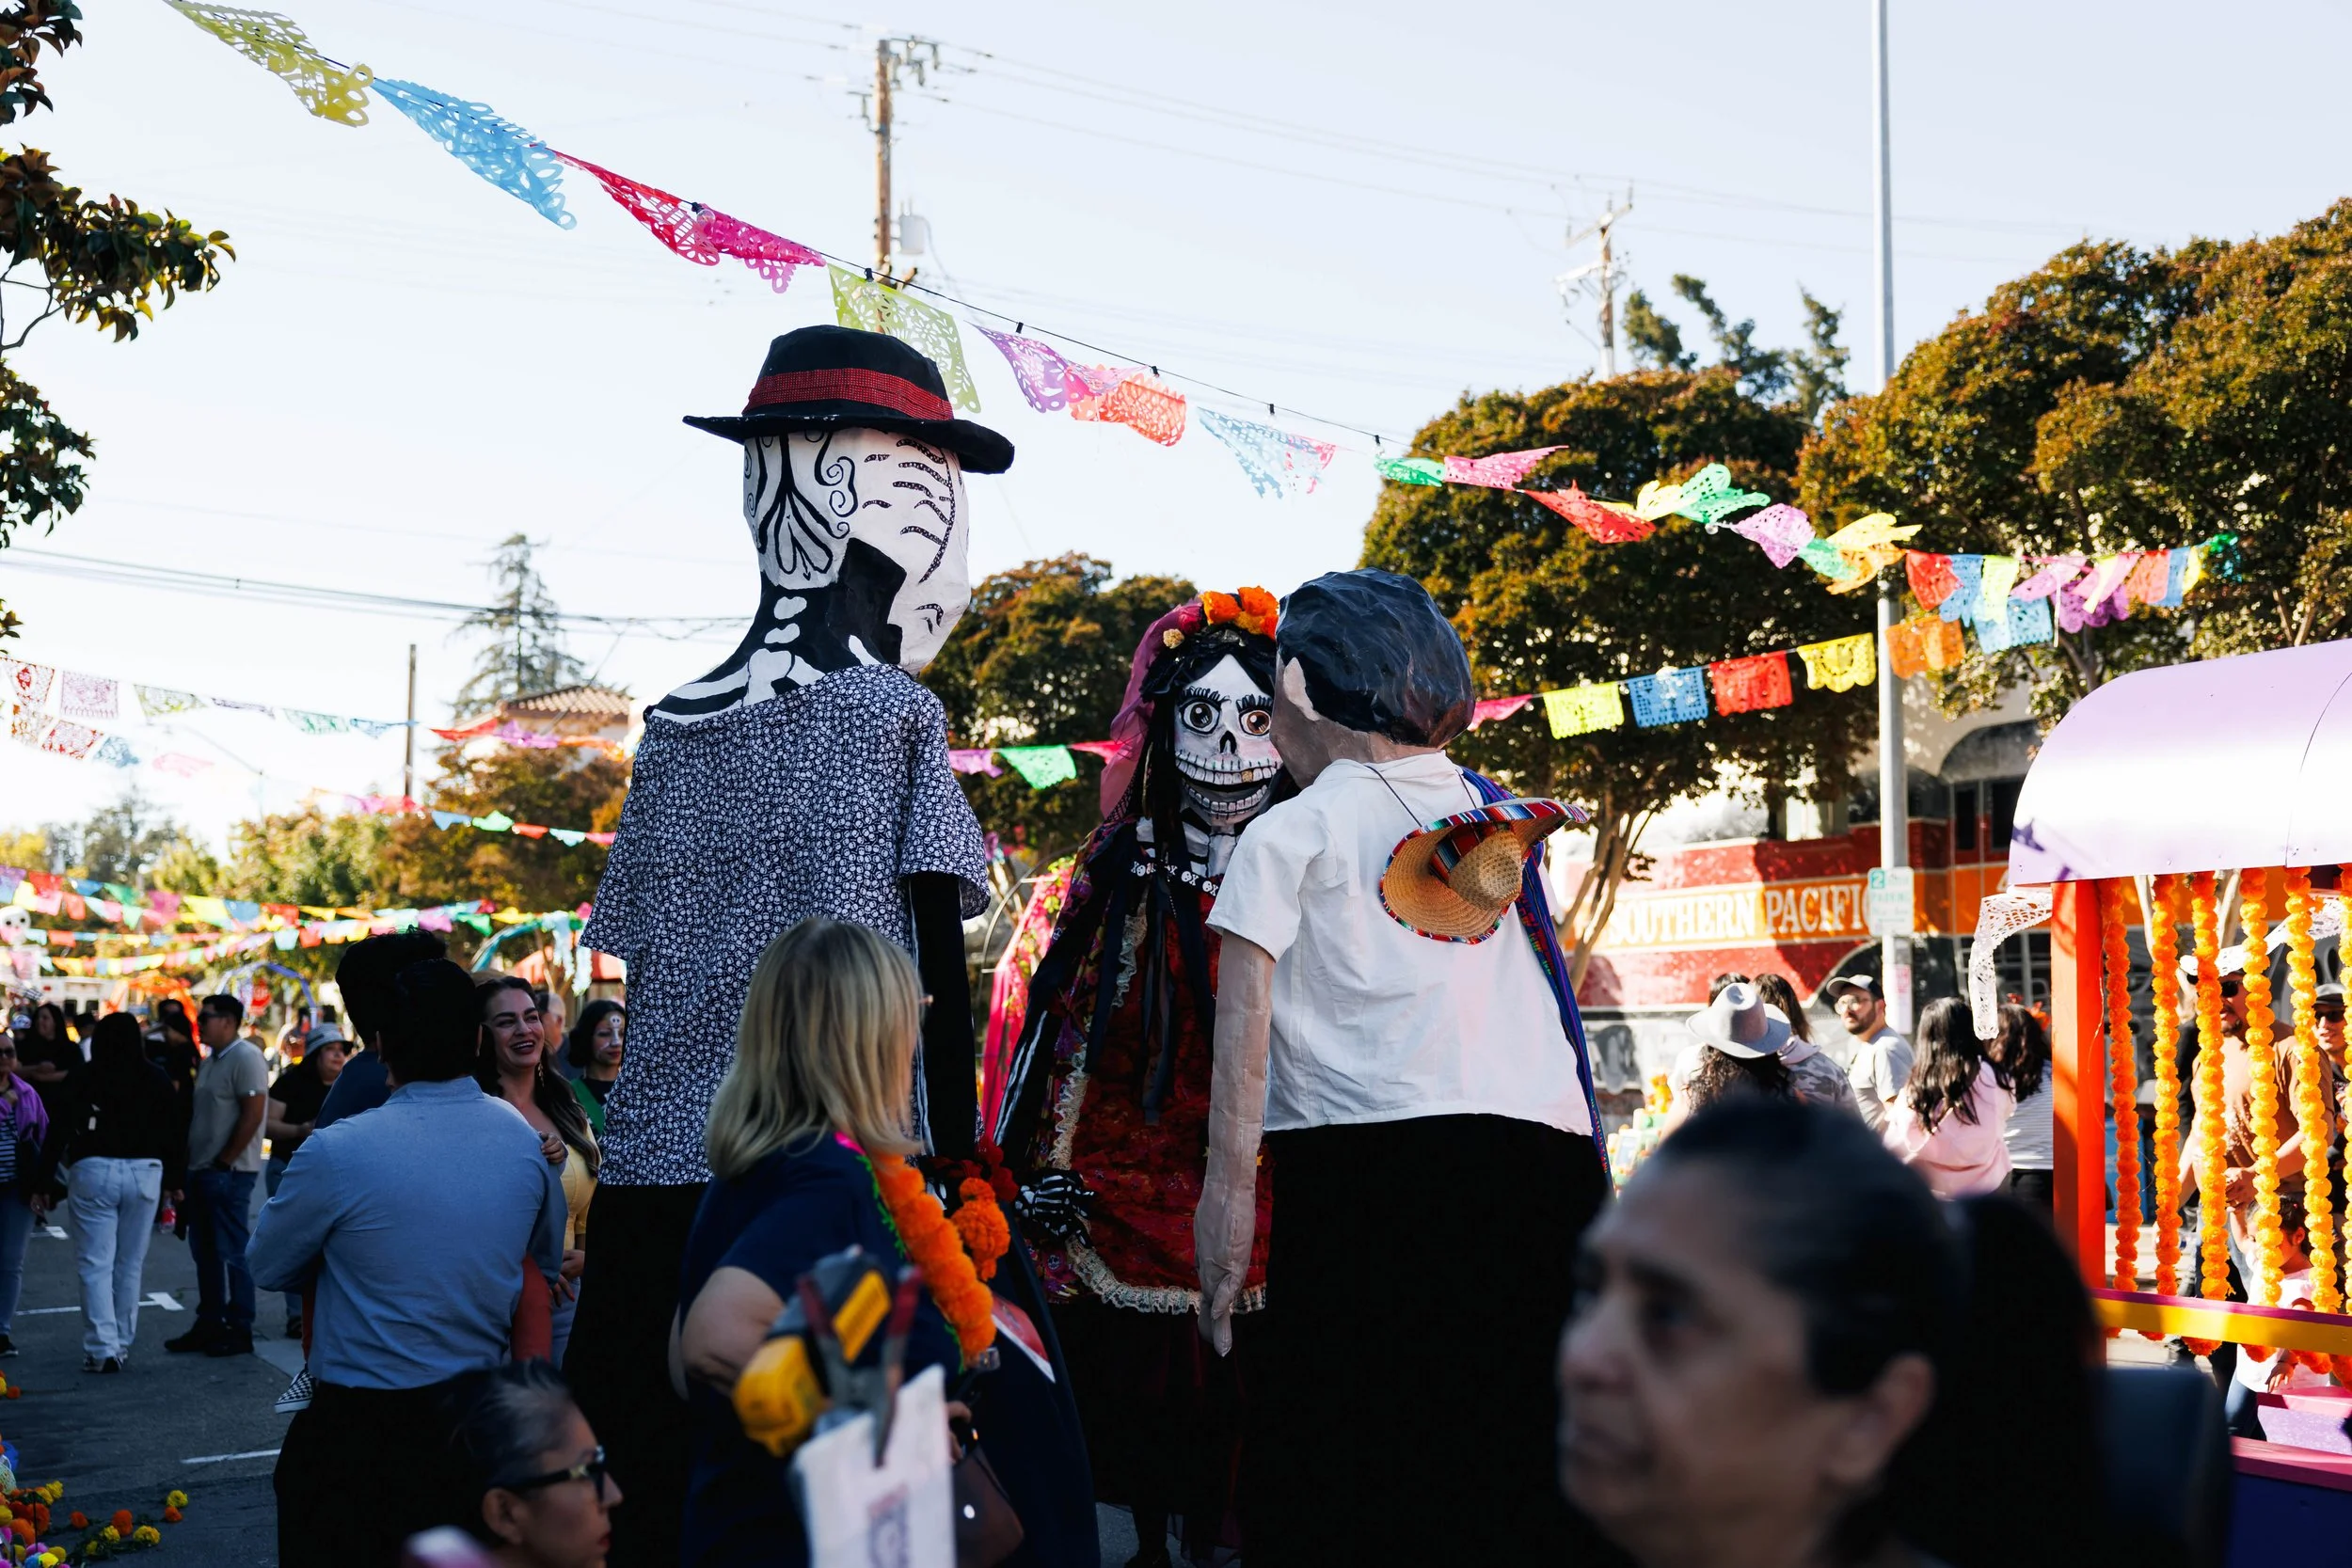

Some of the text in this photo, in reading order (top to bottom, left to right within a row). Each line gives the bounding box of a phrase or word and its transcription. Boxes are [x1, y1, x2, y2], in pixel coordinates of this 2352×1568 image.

[1873, 872, 1884, 888] 2
[1608, 884, 1869, 944] SOUTHERN PACIFI
